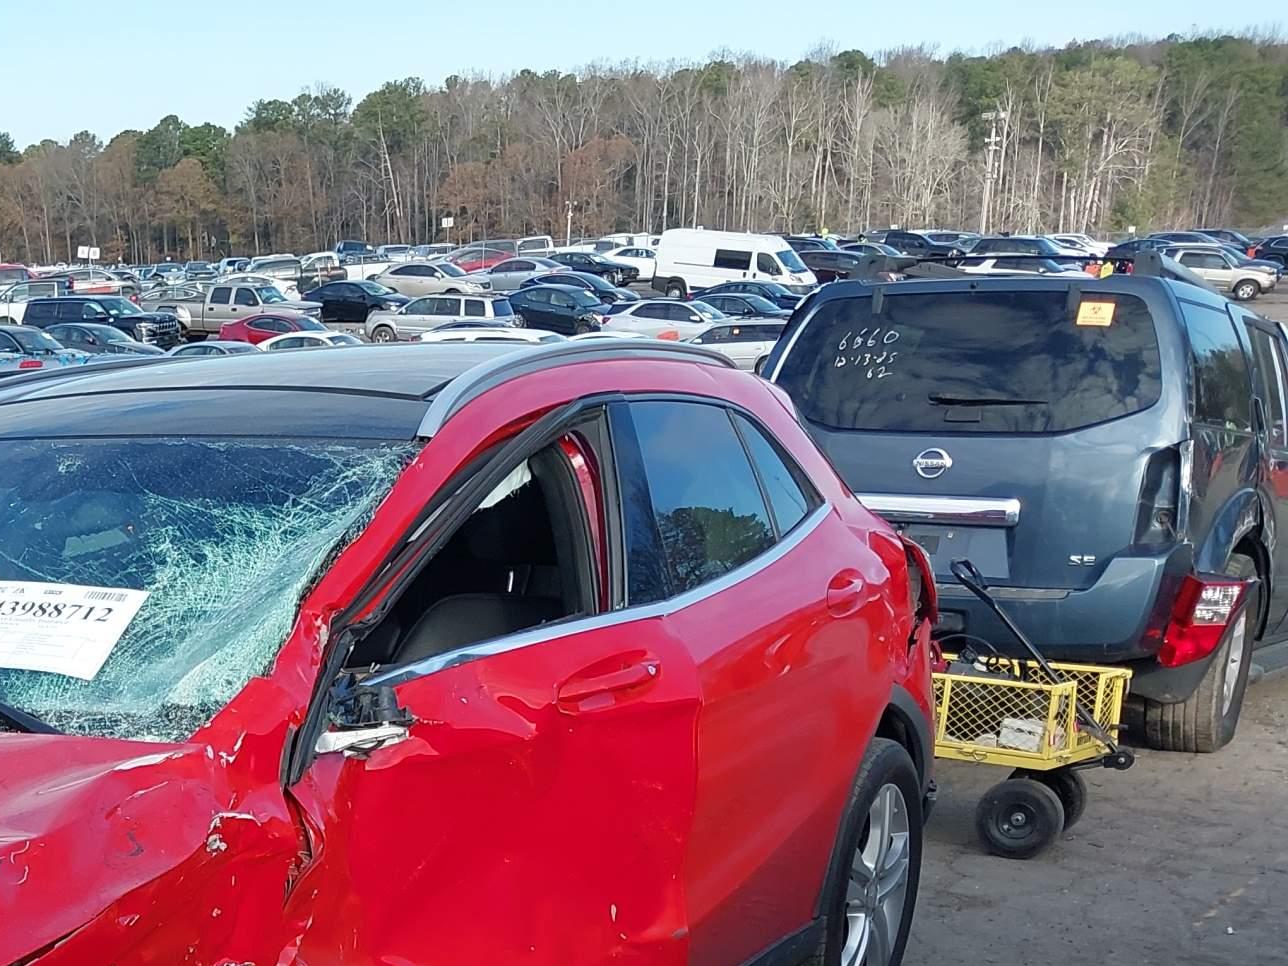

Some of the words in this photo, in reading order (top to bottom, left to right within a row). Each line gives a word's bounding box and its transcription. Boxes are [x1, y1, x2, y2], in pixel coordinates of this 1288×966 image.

[866, 366, 892, 378] 62
[916, 459, 947, 468] NISSAN
[1068, 555, 1096, 566] SE
